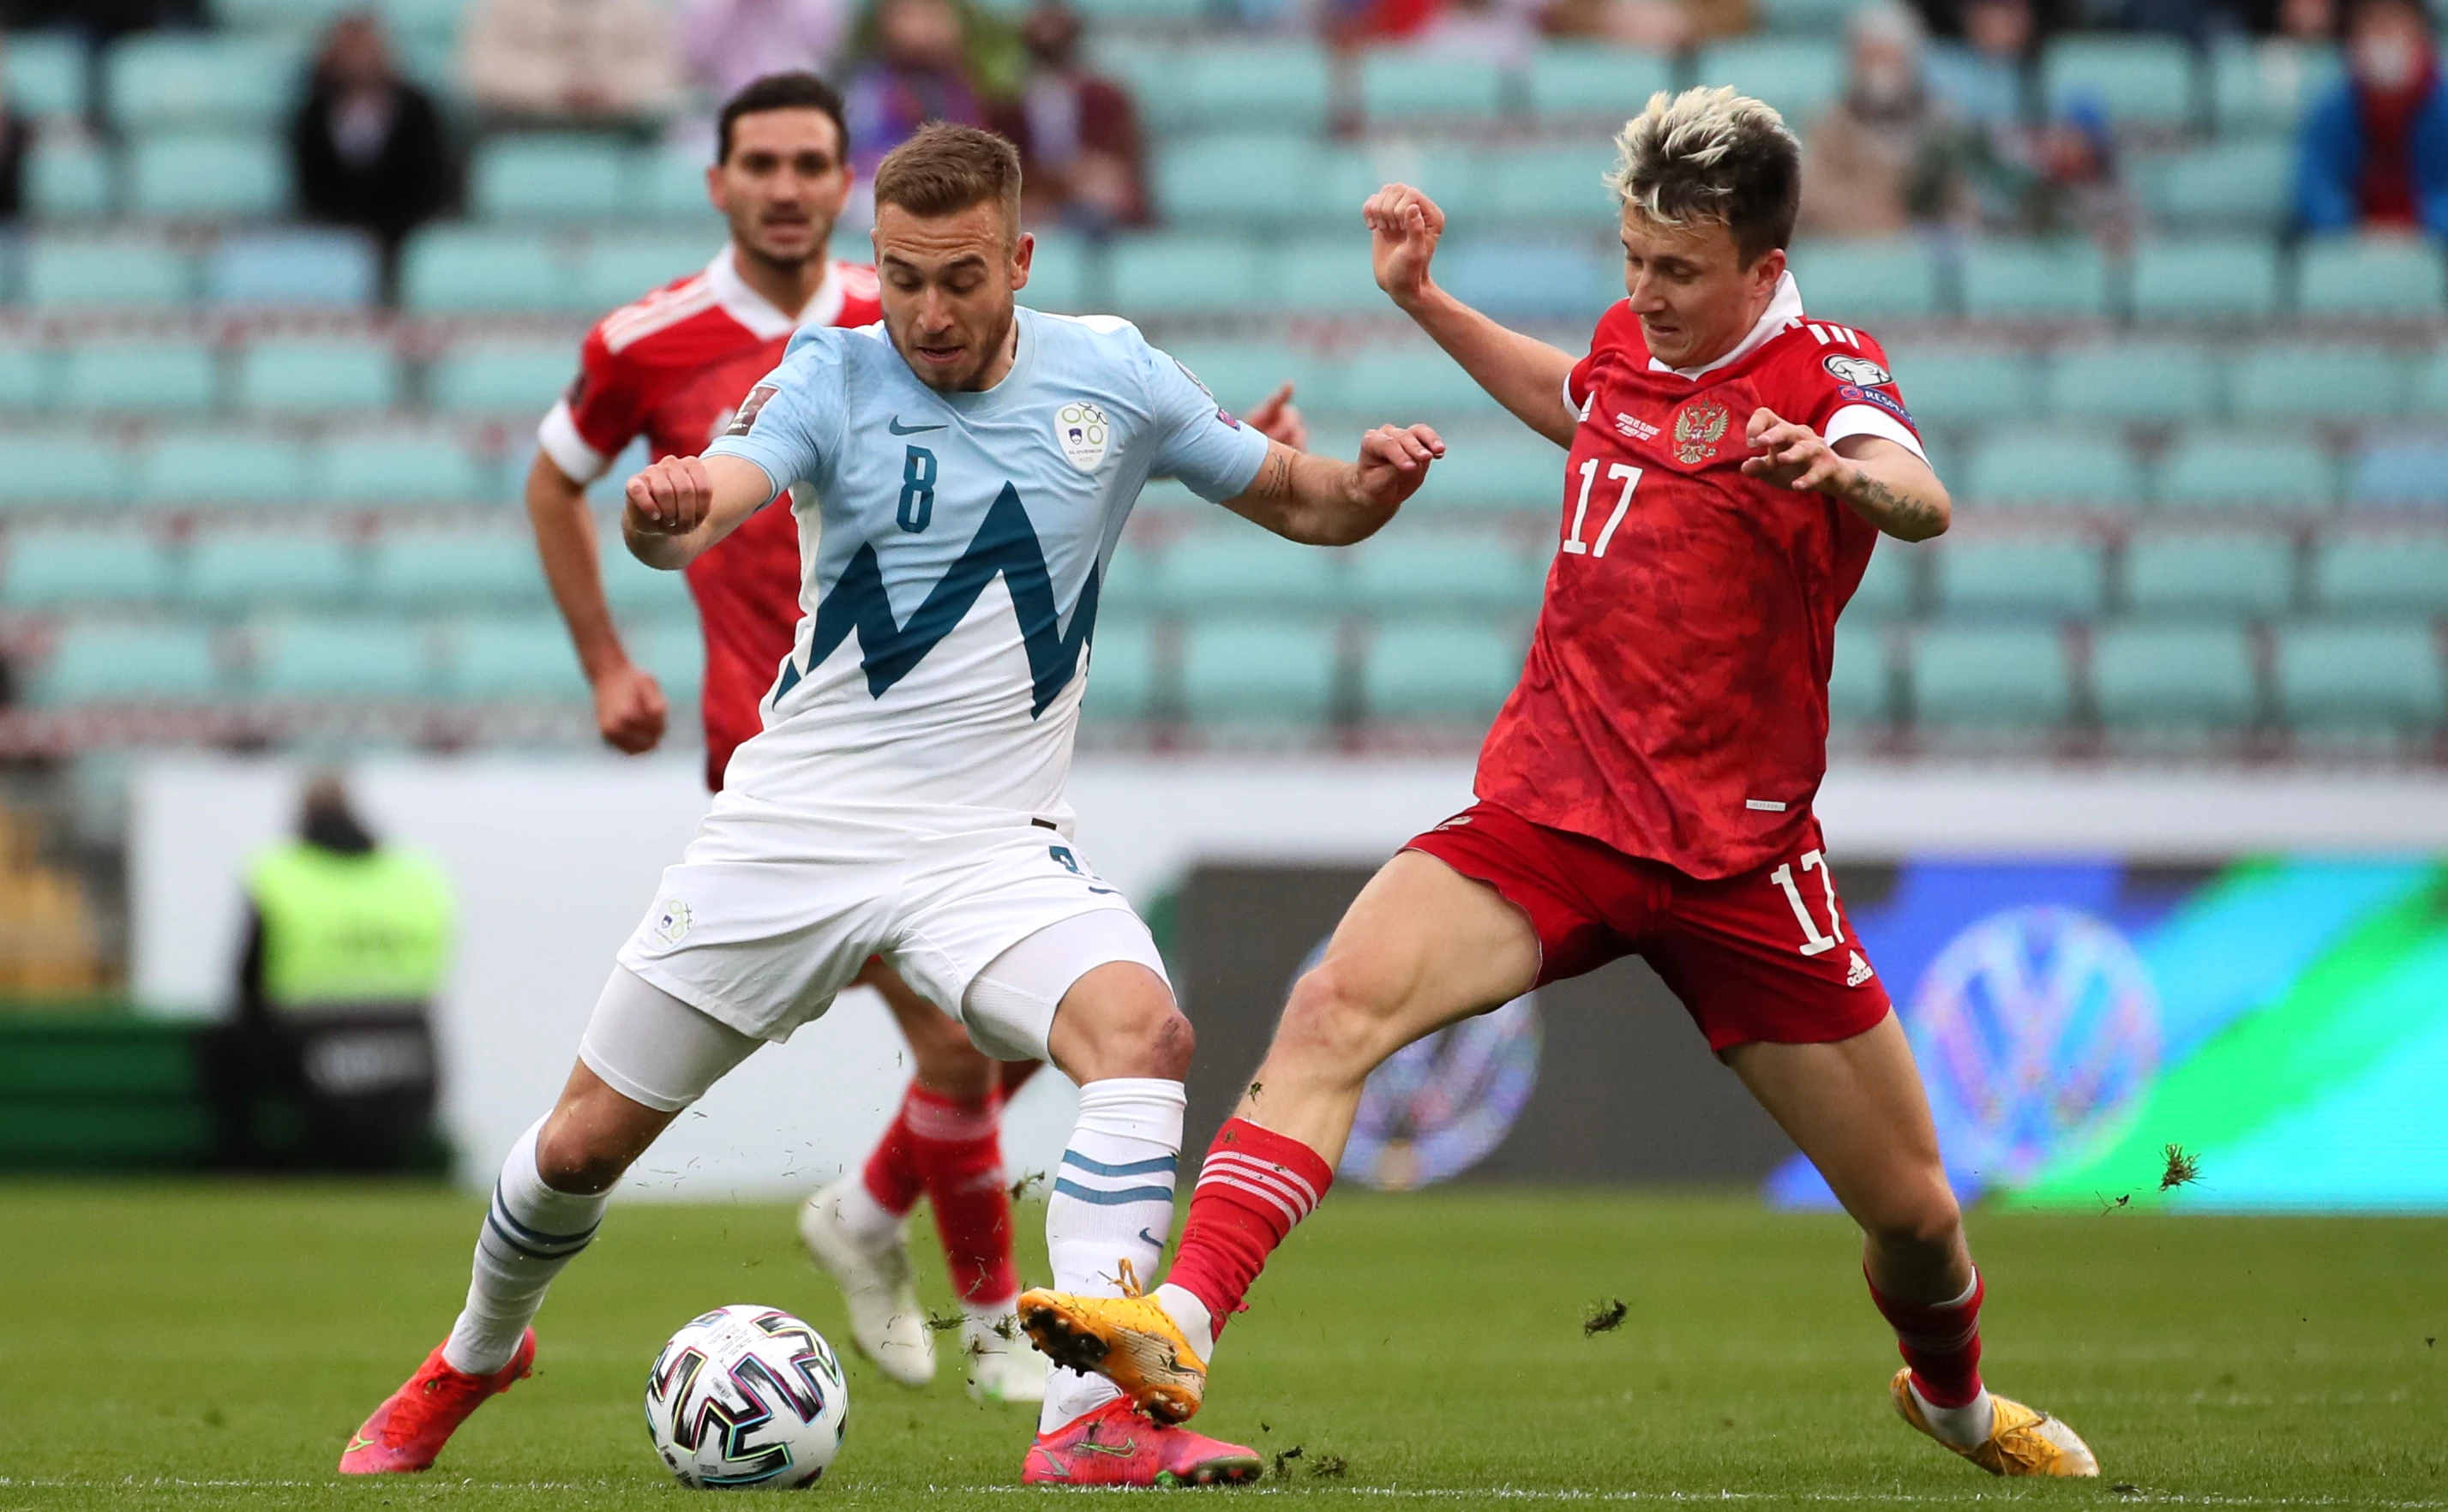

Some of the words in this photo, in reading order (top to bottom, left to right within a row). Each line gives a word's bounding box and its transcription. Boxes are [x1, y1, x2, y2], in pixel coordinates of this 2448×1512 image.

[896, 444, 938, 534] 8
[1563, 458, 1643, 559] 17
[1771, 849, 1845, 957] 17
[1846, 965, 1874, 987] adidas
